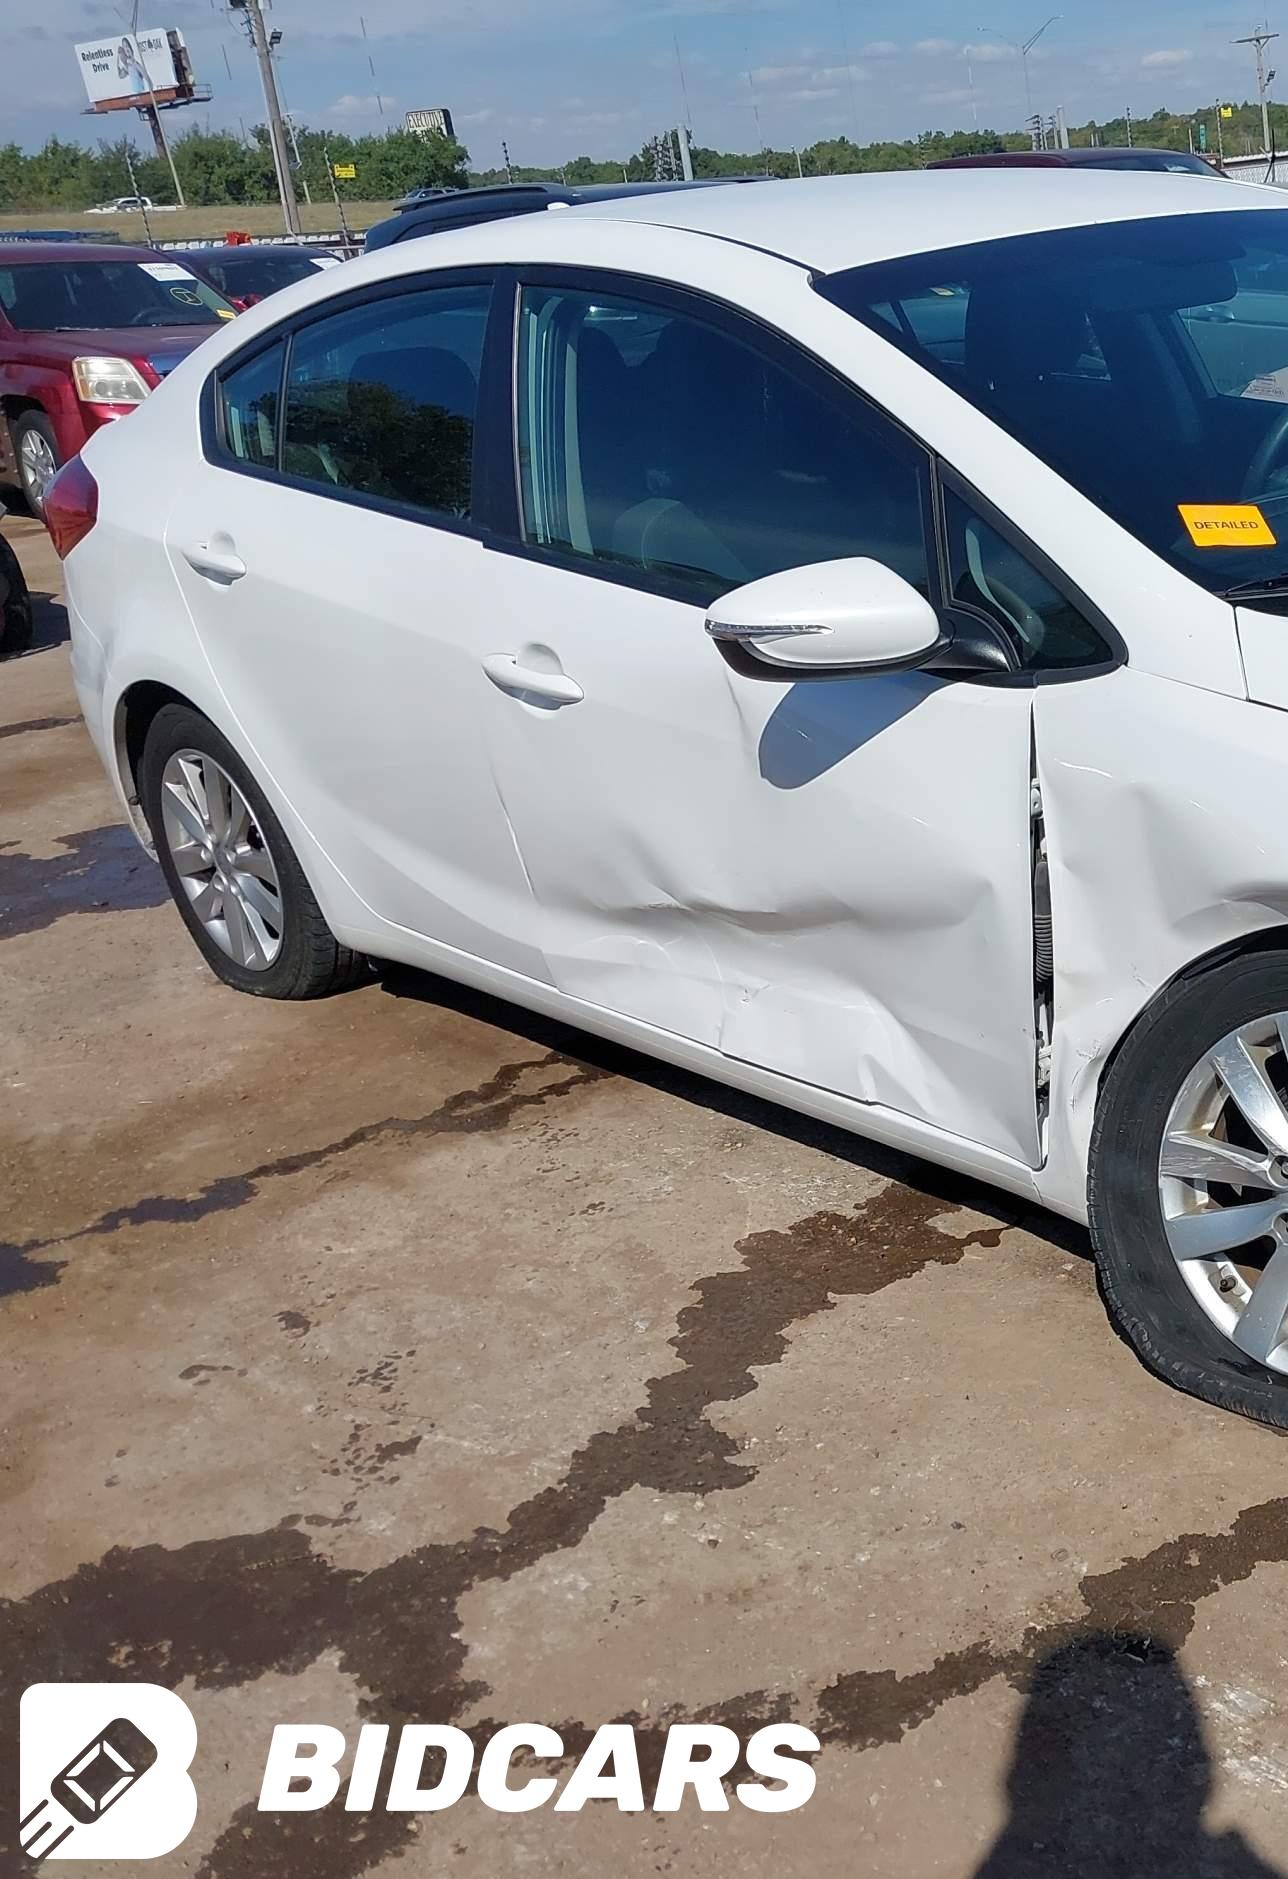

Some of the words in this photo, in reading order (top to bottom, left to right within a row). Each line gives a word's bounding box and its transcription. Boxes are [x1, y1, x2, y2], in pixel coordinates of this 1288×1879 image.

[81, 48, 114, 62] Relentless
[92, 62, 110, 73] Drive
[407, 111, 445, 129] EXECUTIVE
[1193, 520, 1259, 530] DETAILED
